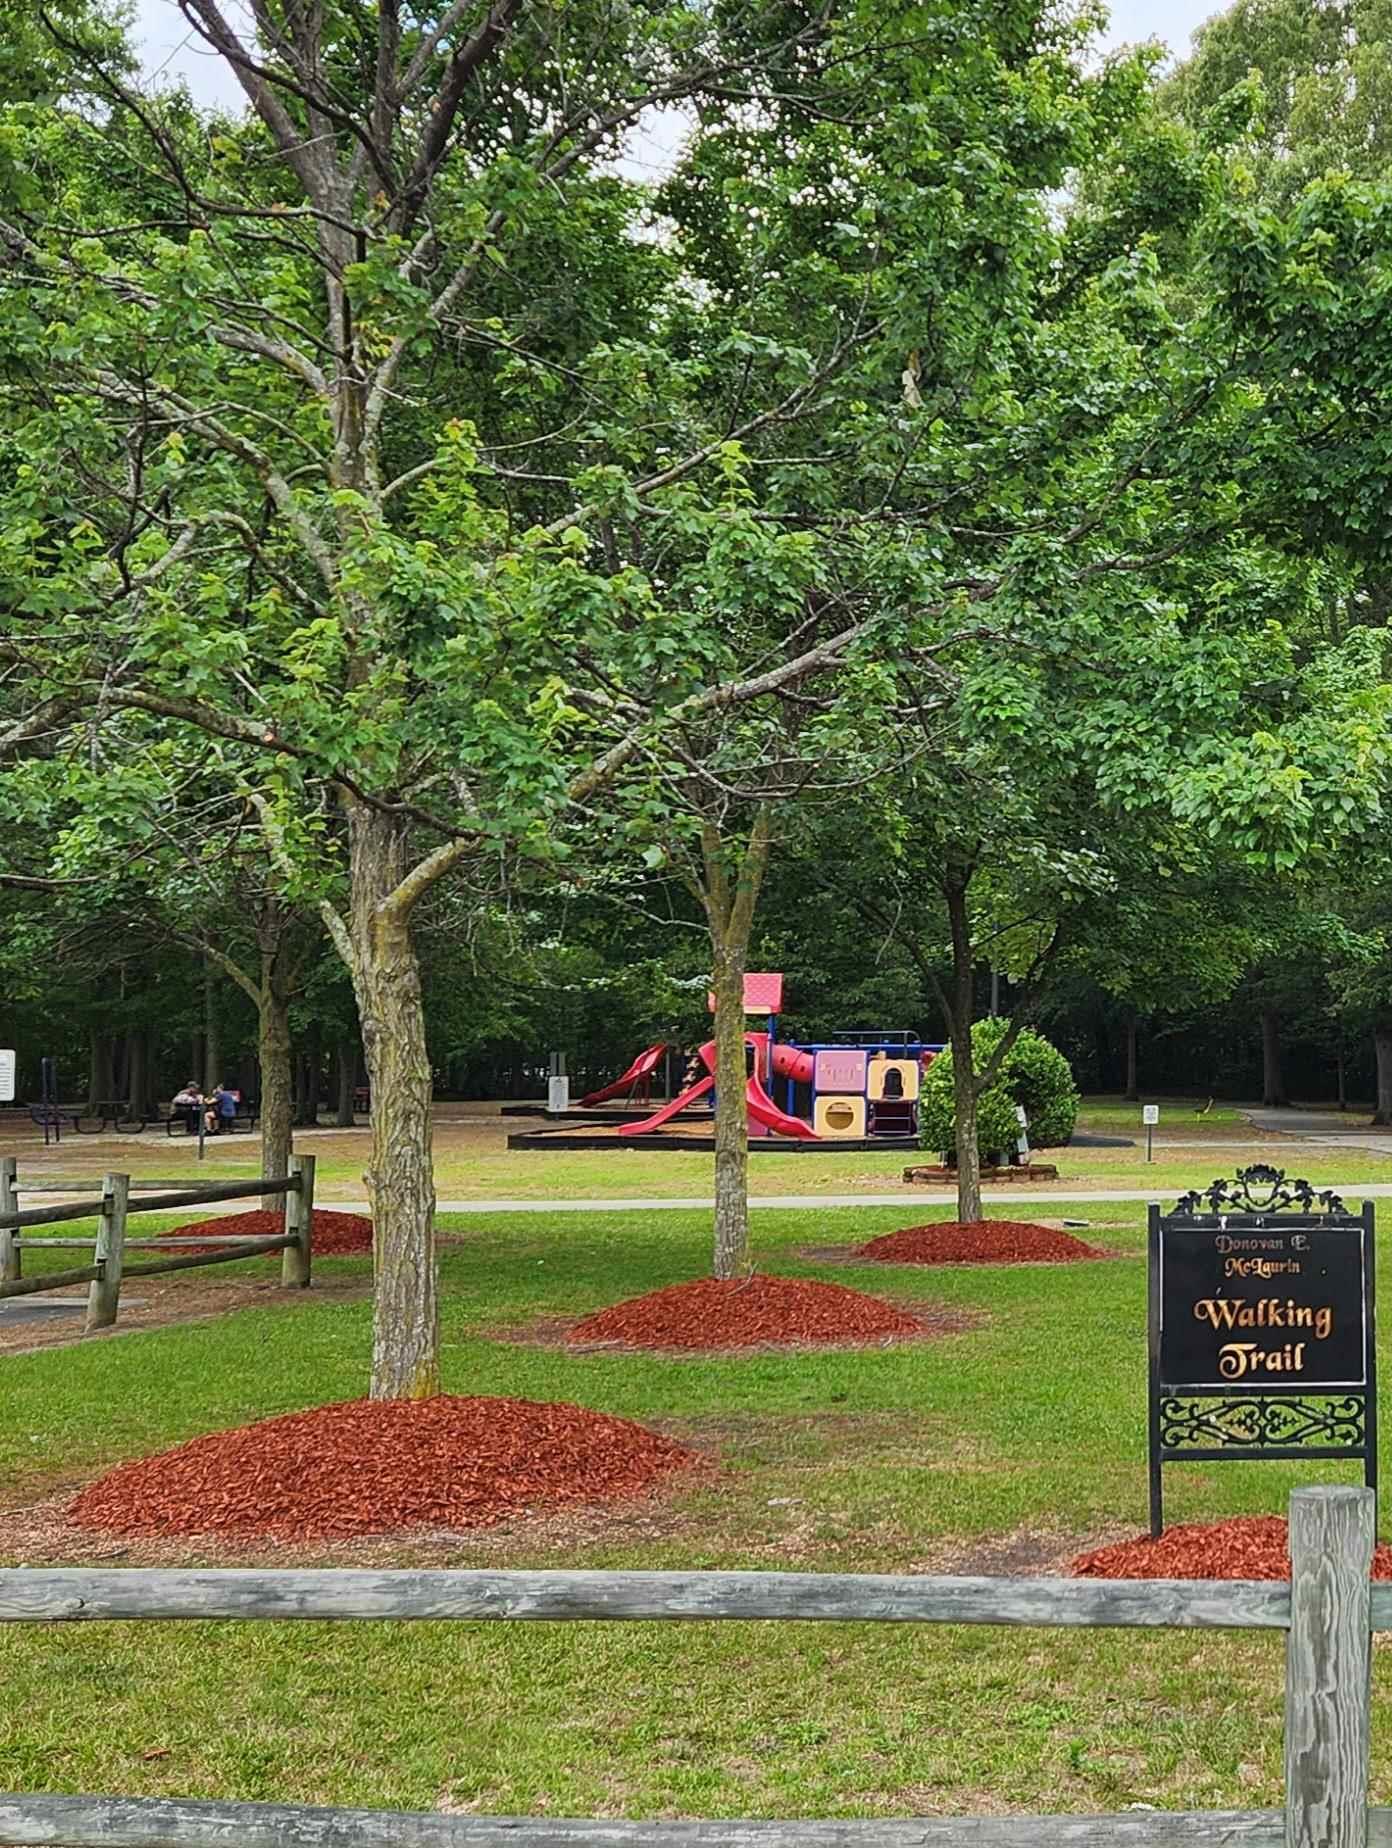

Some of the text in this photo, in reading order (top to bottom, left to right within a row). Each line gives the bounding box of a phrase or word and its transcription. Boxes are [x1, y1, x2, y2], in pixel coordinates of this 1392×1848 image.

[1215, 1235, 1311, 1253] Donovan E.
[1225, 1258, 1300, 1278] McLaurin
[1194, 1299, 1332, 1339] Walking
[1219, 1343, 1304, 1379] Trail
